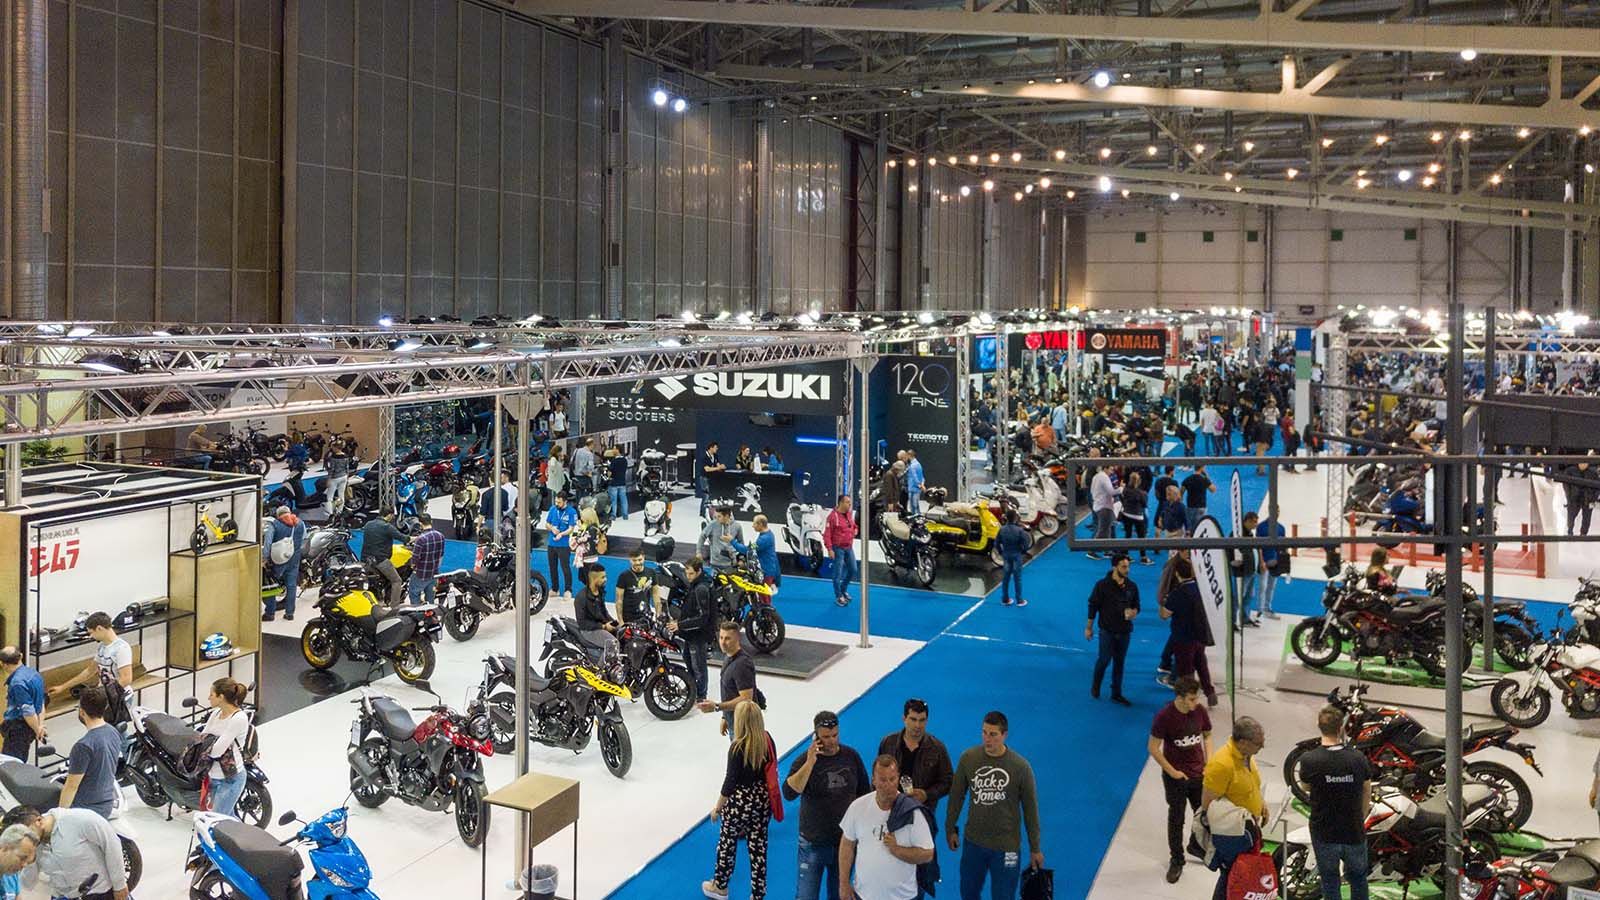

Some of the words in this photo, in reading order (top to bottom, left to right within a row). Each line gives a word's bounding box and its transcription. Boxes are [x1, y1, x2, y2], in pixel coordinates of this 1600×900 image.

[1107, 335, 1160, 349] YAMAHA
[693, 372, 831, 400] SUZUKI
[892, 362, 952, 396] 120
[609, 410, 676, 423] SCOOTERS
[1325, 774, 1354, 783] Benelli
[974, 789, 1007, 804] Jones
